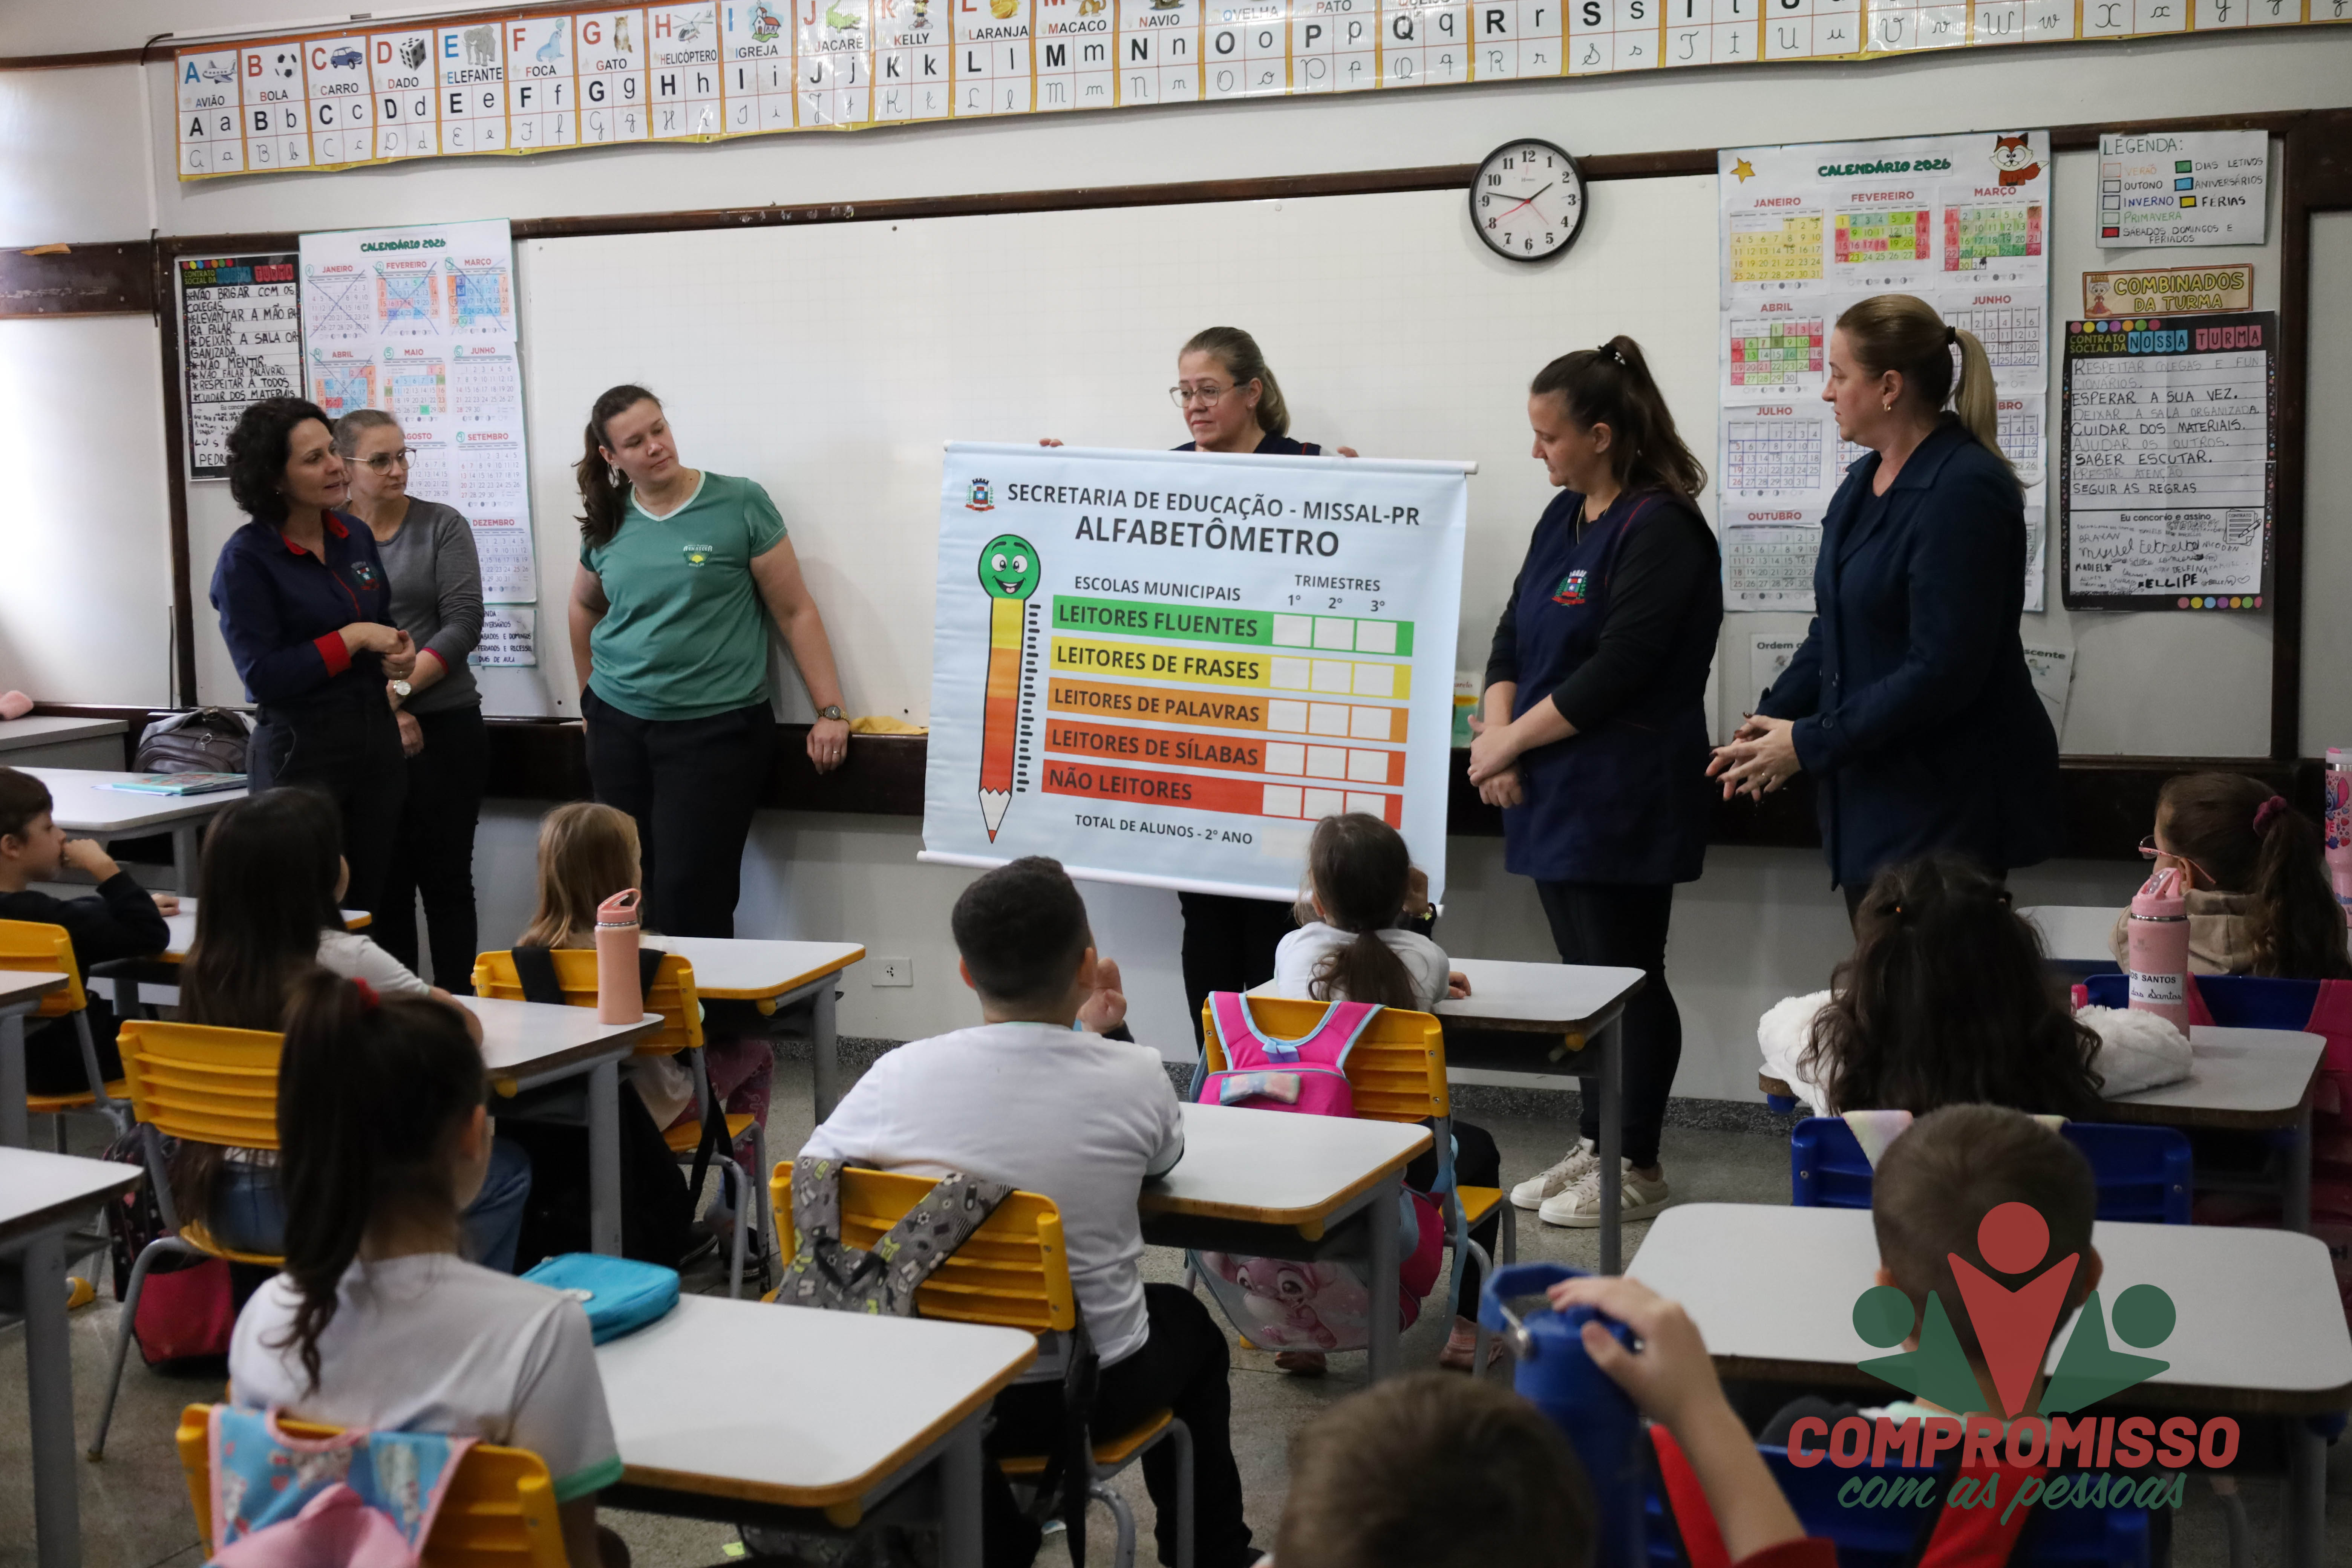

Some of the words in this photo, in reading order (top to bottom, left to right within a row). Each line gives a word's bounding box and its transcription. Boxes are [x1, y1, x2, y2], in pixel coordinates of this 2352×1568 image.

[1223, 5, 1279, 21] OVELHA
[1317, 0, 1352, 13] PATO
[1049, 20, 1106, 34] MACACO
[1140, 14, 1180, 28] NAVIO
[894, 33, 929, 45] KELLY
[969, 26, 1028, 40] LARANJA
[815, 35, 863, 52] JACARÉ
[661, 49, 717, 64] HELICÓPTERO
[736, 45, 778, 58] IGREJA
[526, 65, 556, 77] FOCA
[596, 58, 627, 71] GATO
[447, 67, 502, 84] ELEFANTE
[321, 83, 358, 95] CARRO
[388, 77, 419, 89] DADO
[196, 95, 225, 107] AVIÃO
[260, 90, 288, 101] BOLA
[319, 105, 333, 124] C
[352, 104, 363, 119] c
[220, 116, 231, 131] a
[254, 111, 268, 130] B
[286, 109, 296, 128] b
[189, 120, 204, 136] A
[2103, 139, 2183, 155] LEGENDA:
[1522, 150, 1536, 162] 12
[1547, 156, 1552, 167] 1
[1503, 158, 1514, 169] 11
[1818, 160, 1910, 178] CALENDÁRIO
[1913, 159, 1951, 172] 2026
[2124, 164, 2157, 176] VERÃO
[2195, 161, 2219, 171] DIAS
[2228, 158, 2263, 168] LETIVOS
[1488, 174, 1501, 186] 10
[1562, 172, 1570, 183] 2
[2194, 175, 2263, 189] ANIVERSÁRIOS
[1974, 185, 2017, 197] MARÇO
[2124, 181, 2163, 190] OUTONO
[1482, 195, 1490, 207] 9
[1568, 194, 1576, 205] 3
[1753, 196, 1801, 208] JANEIRO
[1851, 191, 1914, 202] FEVEREIRO
[2124, 196, 2174, 207] INVERNO
[2202, 194, 2246, 207] FÉRIAS
[1489, 217, 1496, 229] 8
[1560, 216, 1568, 227] 4
[2124, 211, 2182, 224] PRIMAVERA
[2123, 227, 2166, 236] SÁBADOS
[2172, 224, 2219, 235] DOMINGOS
[360, 239, 420, 252] CALENDÁRIO
[422, 238, 446, 248] 2026
[1504, 233, 1511, 244] 7
[1525, 239, 1533, 250] 6
[1546, 233, 1553, 244] 5
[2149, 235, 2195, 244] FERIADOS
[464, 258, 492, 266] MARÇO
[322, 265, 353, 273] JANEIRO
[2114, 272, 2244, 295] COMBINADOS
[218, 286, 249, 300] BRIGAR
[1972, 294, 2011, 305] JUNHO
[1760, 302, 1793, 312] ABRIL
[2135, 297, 2156, 312] DA
[2162, 294, 2223, 310] TURMA
[240, 333, 248, 345] A
[255, 332, 280, 344] SALA
[2070, 334, 2125, 343] CONTRATO
[2129, 335, 2186, 348] NOSSA
[2199, 331, 2259, 346] TURMA
[2070, 344, 2109, 353] SOCIAL
[2113, 343, 2127, 352] DA
[2075, 358, 2145, 375] RESPEITAR
[2216, 360, 2223, 369] E
[200, 378, 243, 390] RESPEITAR
[248, 378, 256, 388] A
[2072, 391, 2136, 405] ESPERAR
[2151, 392, 2159, 403] A
[2167, 391, 2194, 403] SUA
[2207, 388, 2238, 401] VEZ.
[1756, 406, 1793, 416] JULHO
[2073, 409, 2121, 420] DEIXAR
[2136, 408, 2143, 419] A
[2151, 407, 2179, 418] SALA
[2071, 423, 2130, 436] CUIDAR
[2141, 424, 2166, 434] DOS
[468, 432, 508, 441] SETEMBRO
[2073, 438, 2131, 452] AJUDAR
[2142, 439, 2158, 449] OS
[2075, 453, 2125, 466] SABER
[2139, 450, 2213, 465] ESCUTAR.
[2073, 467, 2123, 479] PRESTAR
[2073, 483, 2117, 494] SEGUIR
[2124, 484, 2140, 493] AS
[2149, 483, 2197, 494] REGRAS
[1008, 484, 1129, 507] SECRETARIA
[1135, 491, 1159, 509] DE
[1167, 493, 1282, 520] EDUCAÇÃO
[1304, 501, 1419, 525] MISSAL-PR
[473, 518, 515, 527] DEZEMBRO
[1748, 511, 1802, 521] OUTUBRO
[1075, 516, 1338, 557] ALFABETÔMETRO
[1075, 576, 1139, 593] ESCOLAS
[1144, 582, 1240, 601] MUNICIPAIS
[1295, 575, 1380, 591] TRIMESTRES
[1060, 605, 1147, 628] LEITORES
[1155, 612, 1257, 637] FLUENTES
[1757, 641, 1793, 650] Ordem
[1058, 645, 1146, 670] LEITORES
[1153, 655, 1177, 673] DE
[1184, 657, 1259, 679] FRASES
[1055, 688, 1132, 710] LEITORES
[1138, 697, 1159, 713] DE
[1165, 699, 1259, 722] PALAVRAS
[1052, 729, 1139, 754] LEITORES
[1145, 739, 1169, 755] DE
[1175, 738, 1257, 766] SÍLABAS
[1049, 768, 1093, 790] NÃO
[1099, 775, 1192, 800] LEITORES
[1075, 815, 1115, 829] TOTAL
[1120, 819, 1135, 831] DE
[1139, 822, 1193, 838] ALUNOS
[1222, 831, 1252, 844] ANO
[2142, 974, 2176, 983] SANTOS
[2148, 989, 2182, 1000] Santos
